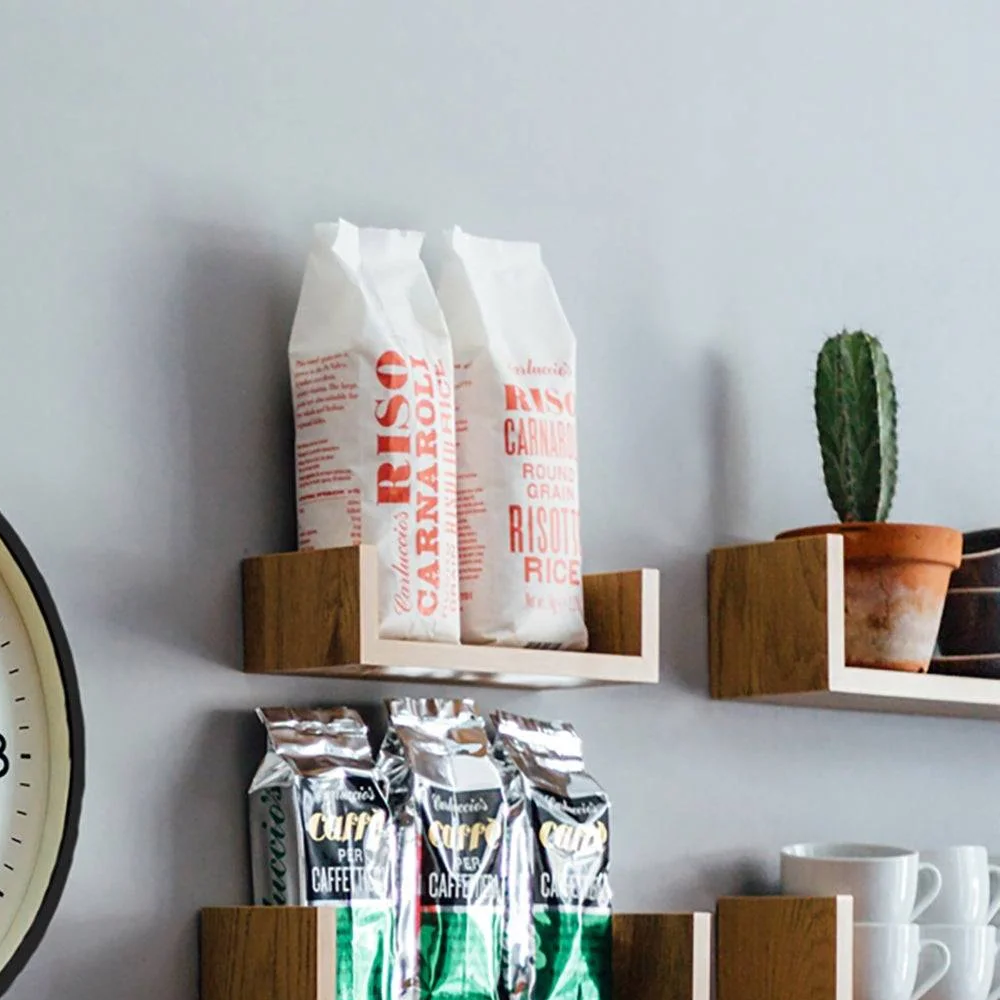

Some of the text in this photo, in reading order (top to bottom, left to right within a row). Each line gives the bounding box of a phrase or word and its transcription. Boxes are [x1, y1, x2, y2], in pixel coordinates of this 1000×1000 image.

[375, 350, 412, 505] RISO
[409, 355, 440, 616] CARNAROLI
[522, 463, 574, 482] ROUND
[527, 483, 574, 500] GRAIN
[508, 504, 580, 556] RISOTT
[393, 511, 410, 615] Carluccio's
[523, 556, 581, 586] RICE
[260, 786, 287, 906] uccio's
[338, 848, 365, 863] PER
